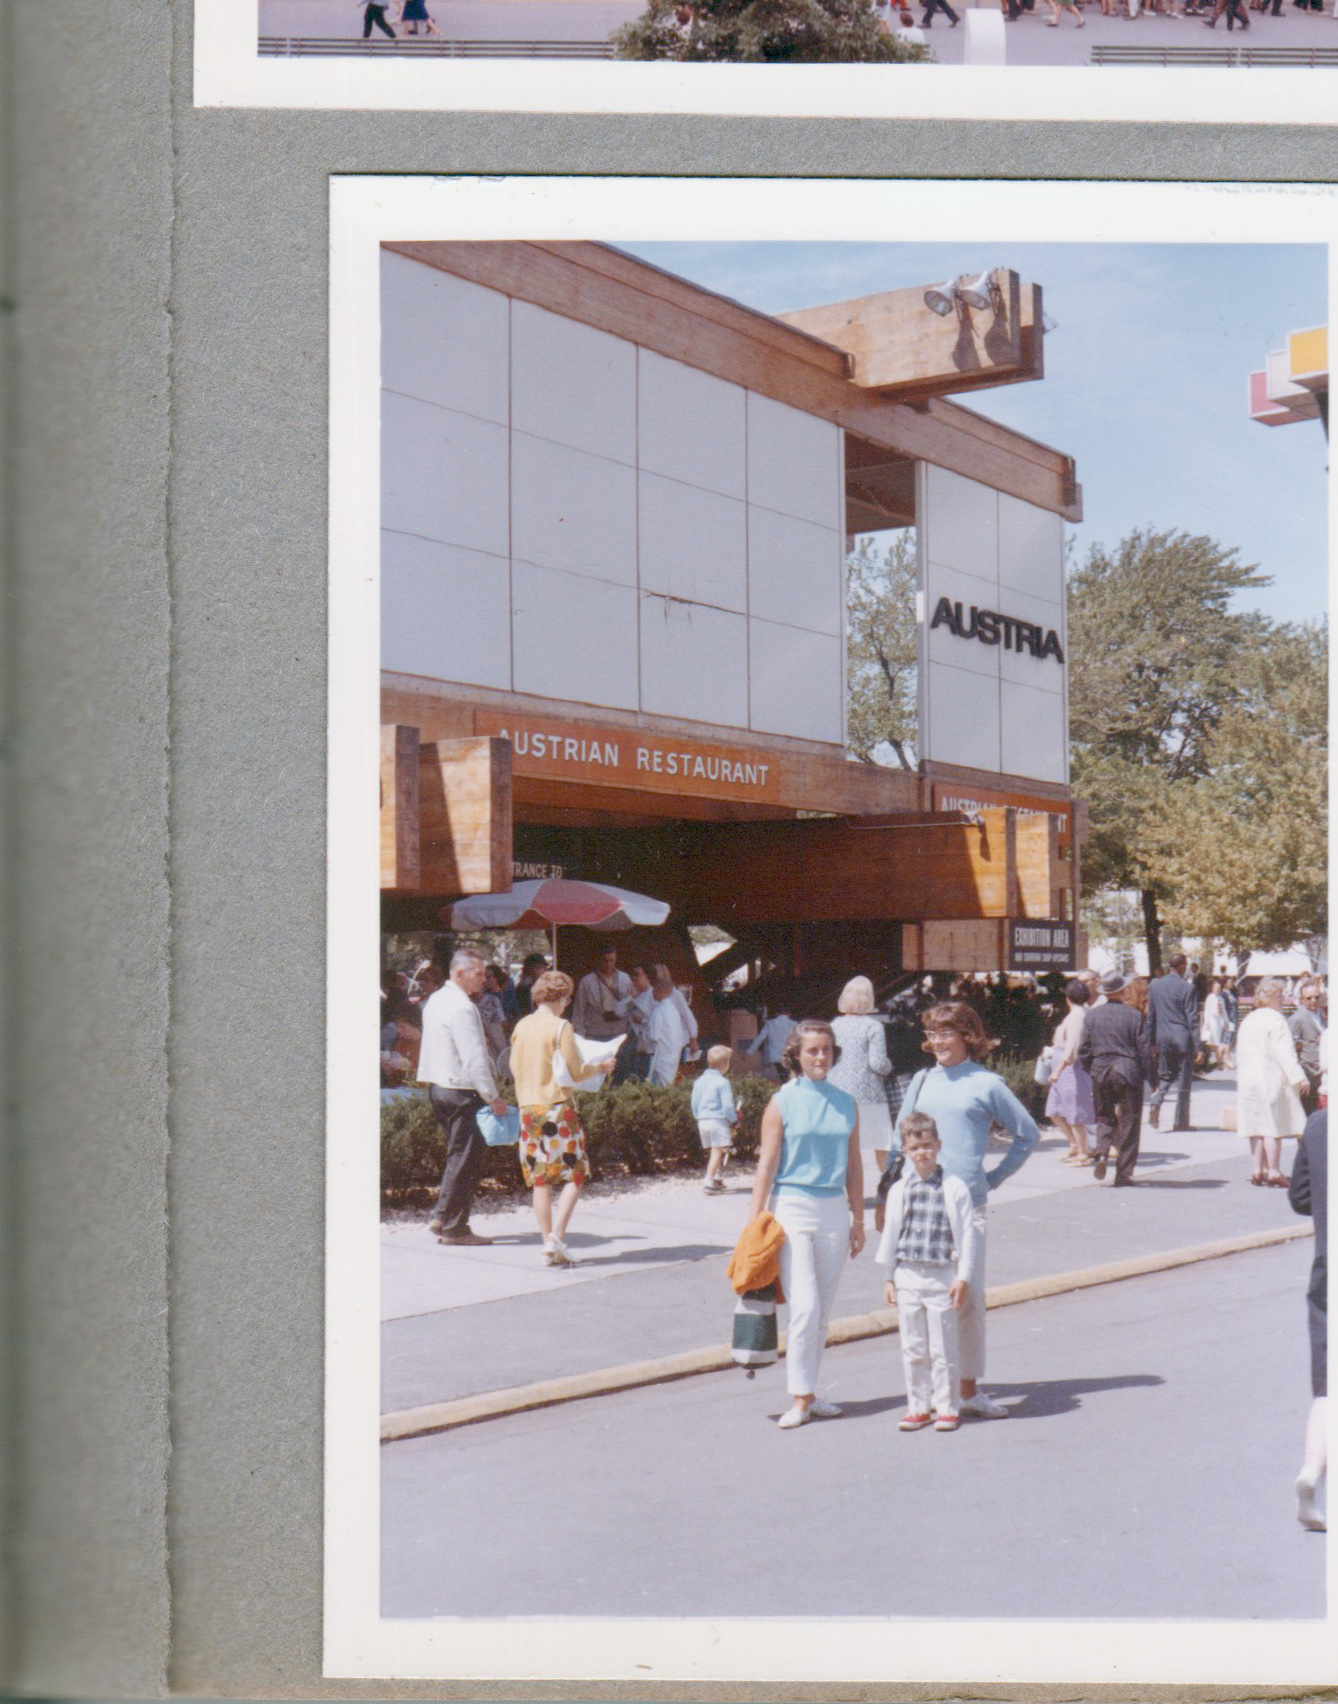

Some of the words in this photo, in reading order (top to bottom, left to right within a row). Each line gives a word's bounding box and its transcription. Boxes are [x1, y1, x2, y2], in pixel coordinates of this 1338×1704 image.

[930, 597, 1065, 664] AUSTRIA
[637, 748, 769, 786] RESTAURANT
[1015, 927, 1051, 947] EXHIBITION
[1053, 929, 1069, 948] AREA
